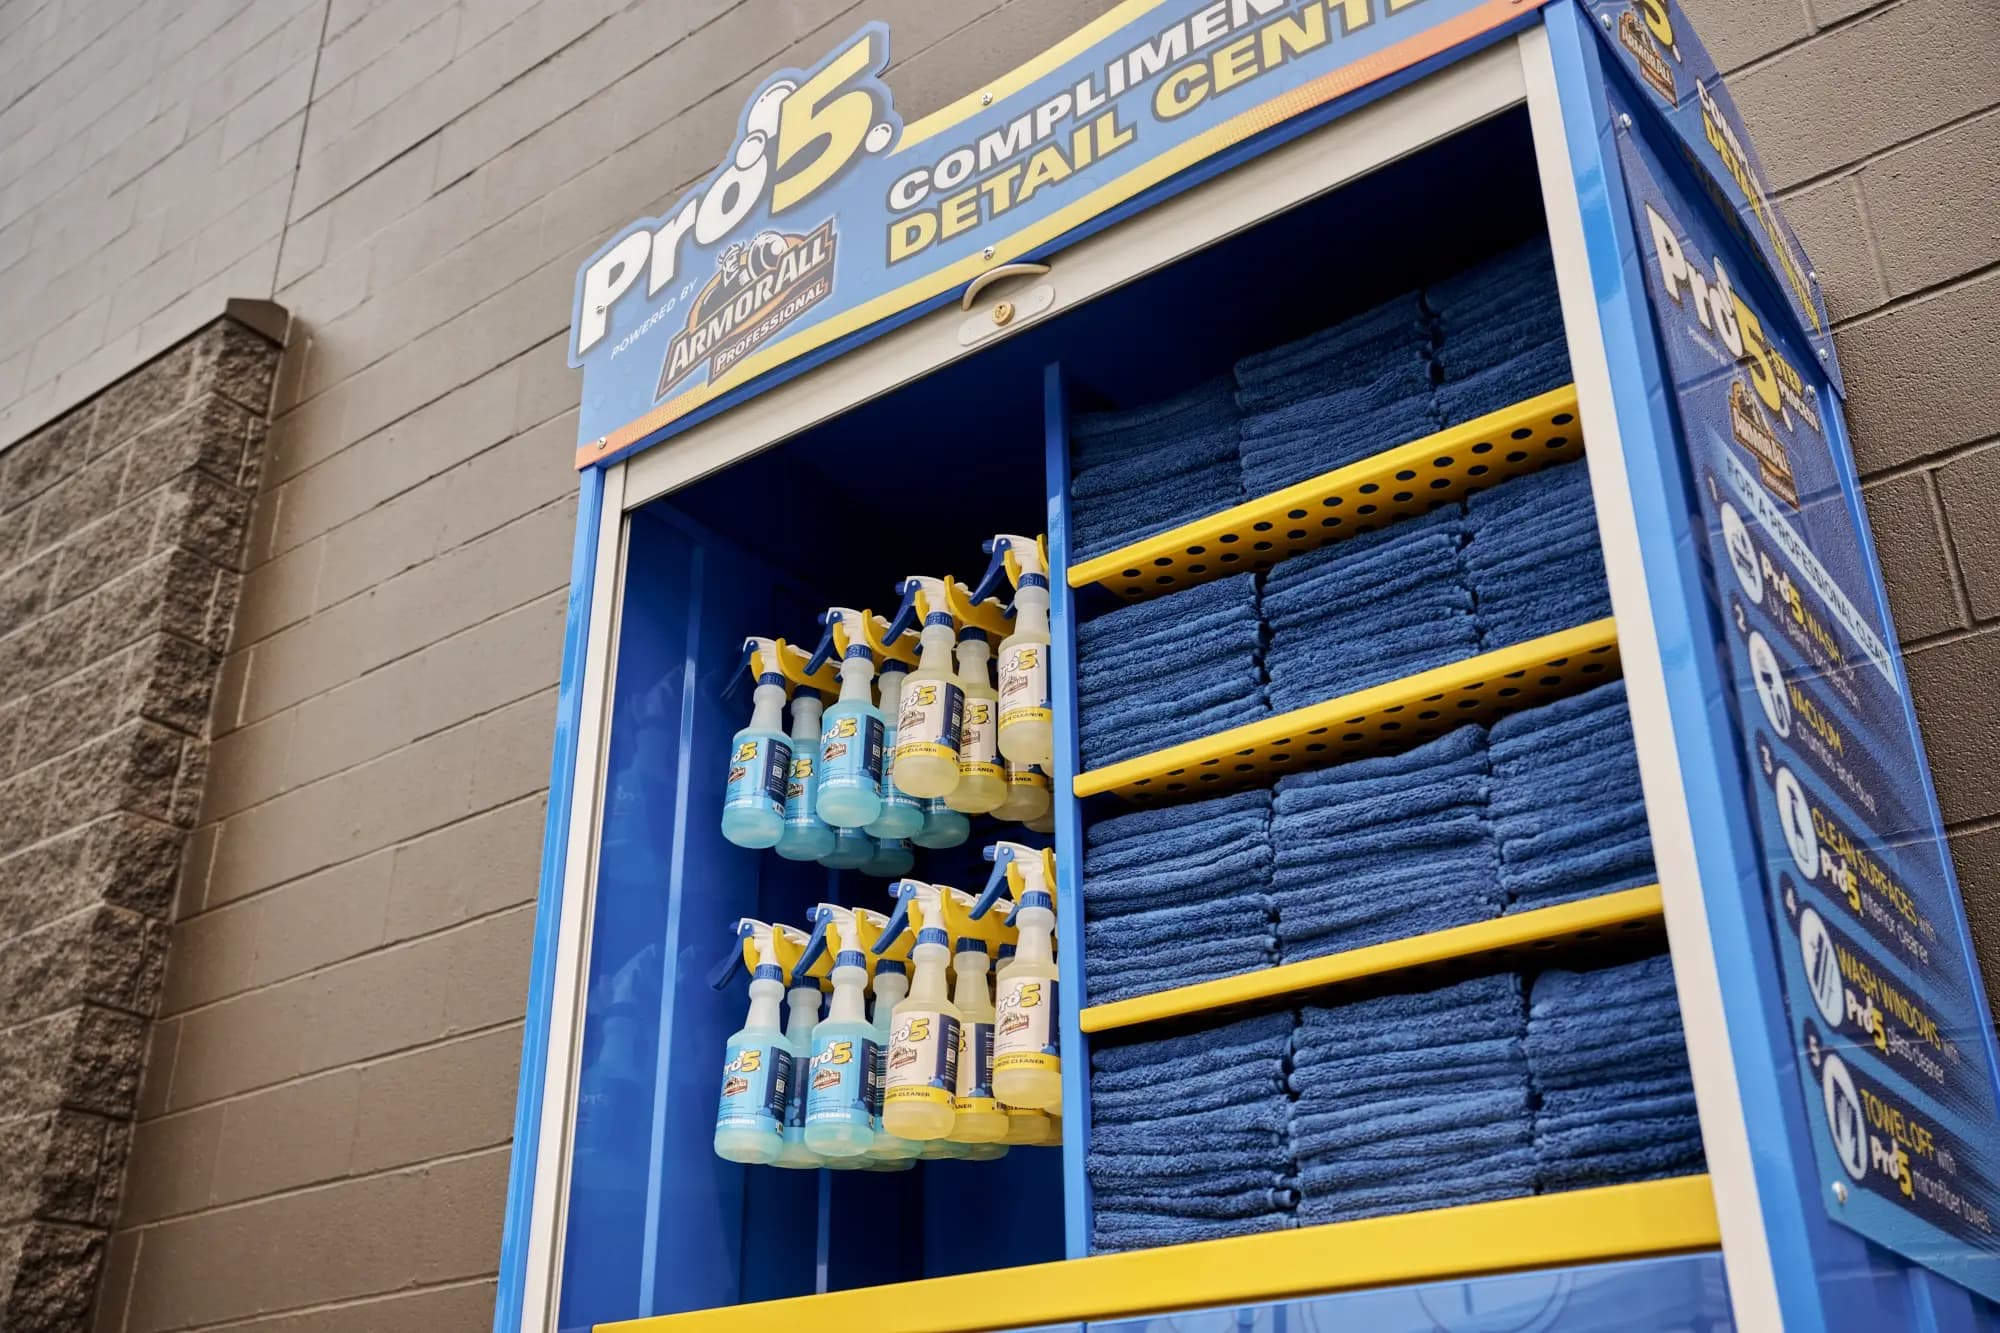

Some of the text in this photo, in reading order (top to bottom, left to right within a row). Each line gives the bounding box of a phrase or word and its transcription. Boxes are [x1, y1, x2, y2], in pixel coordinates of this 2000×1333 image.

[889, 111, 1134, 264] DETAIL
[610, 278, 698, 361] POWERED BY
[714, 284, 826, 373] PROFESSIONAL
[1726, 458, 1754, 500] FOR
[1735, 603, 1747, 633] 2
[1788, 682, 1844, 758] VACUUM
[1761, 745, 1773, 775] 3
[1812, 807, 1858, 870] CLEAN
[1856, 848, 1918, 927] SURFACES
[1835, 944, 1880, 1004] WASH
[1878, 977, 1942, 1051] WINDOWS
[1912, 1044, 1945, 1086] cleaner
[1860, 1088, 1913, 1149] TOWEL
[1910, 1121, 1935, 1161] OFF
